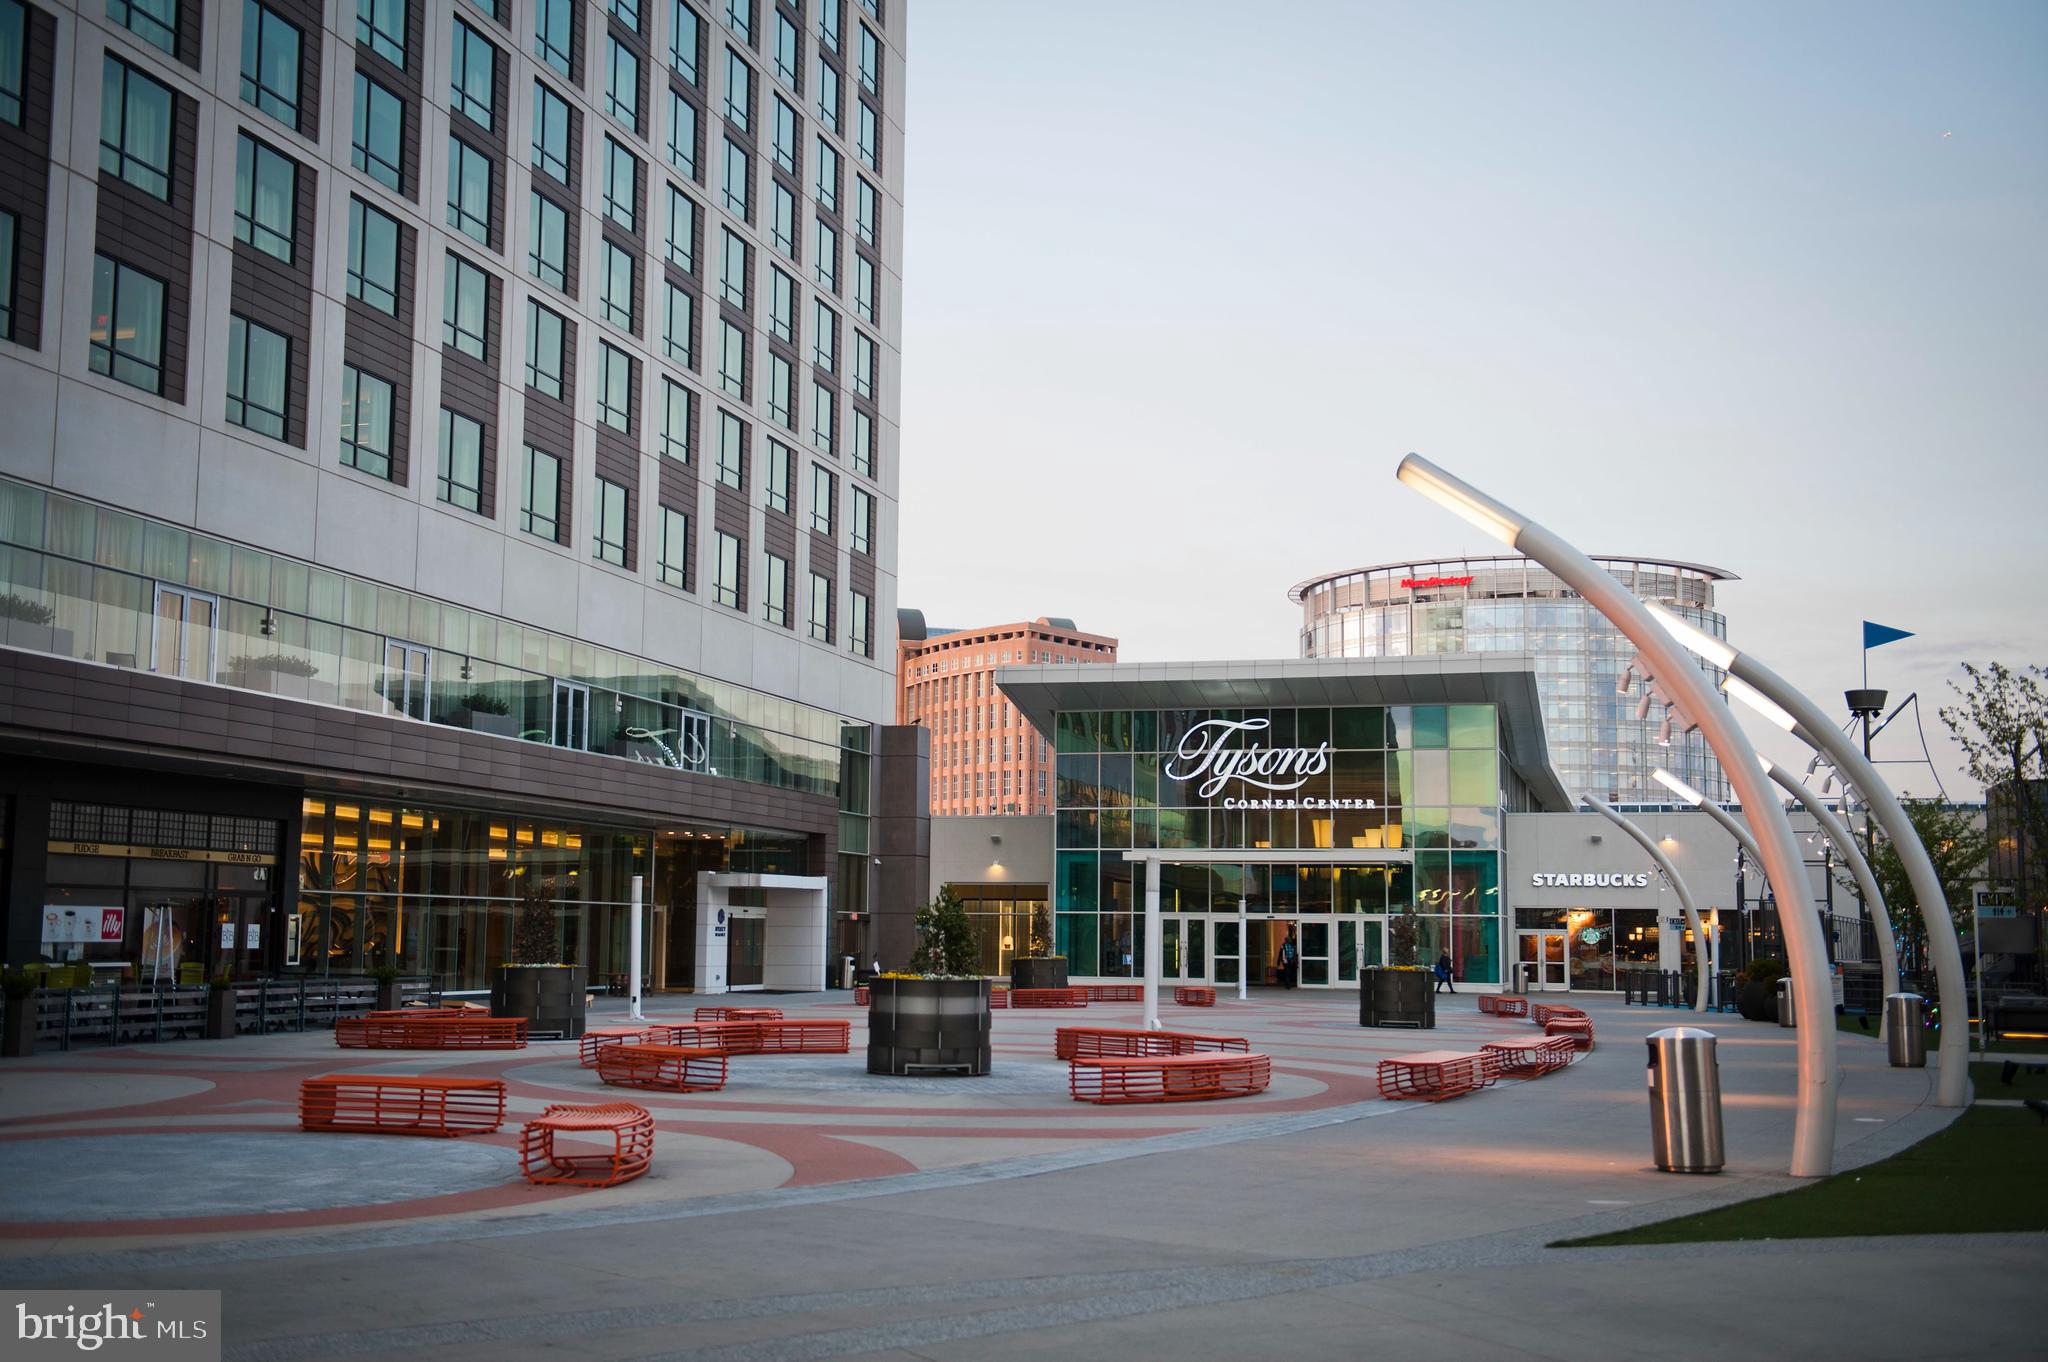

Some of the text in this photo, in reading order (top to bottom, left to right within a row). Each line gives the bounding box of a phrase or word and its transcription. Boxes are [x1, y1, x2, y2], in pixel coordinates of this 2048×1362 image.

[1165, 718, 1328, 798] Tysons
[73, 843, 100, 854] FUDGE
[150, 848, 190, 859] BREAKFAST
[227, 852, 246, 863] GRAB
[251, 854, 262, 864] GO
[1532, 873, 1648, 887] STARBUCKS
[102, 913, 121, 936] illy
